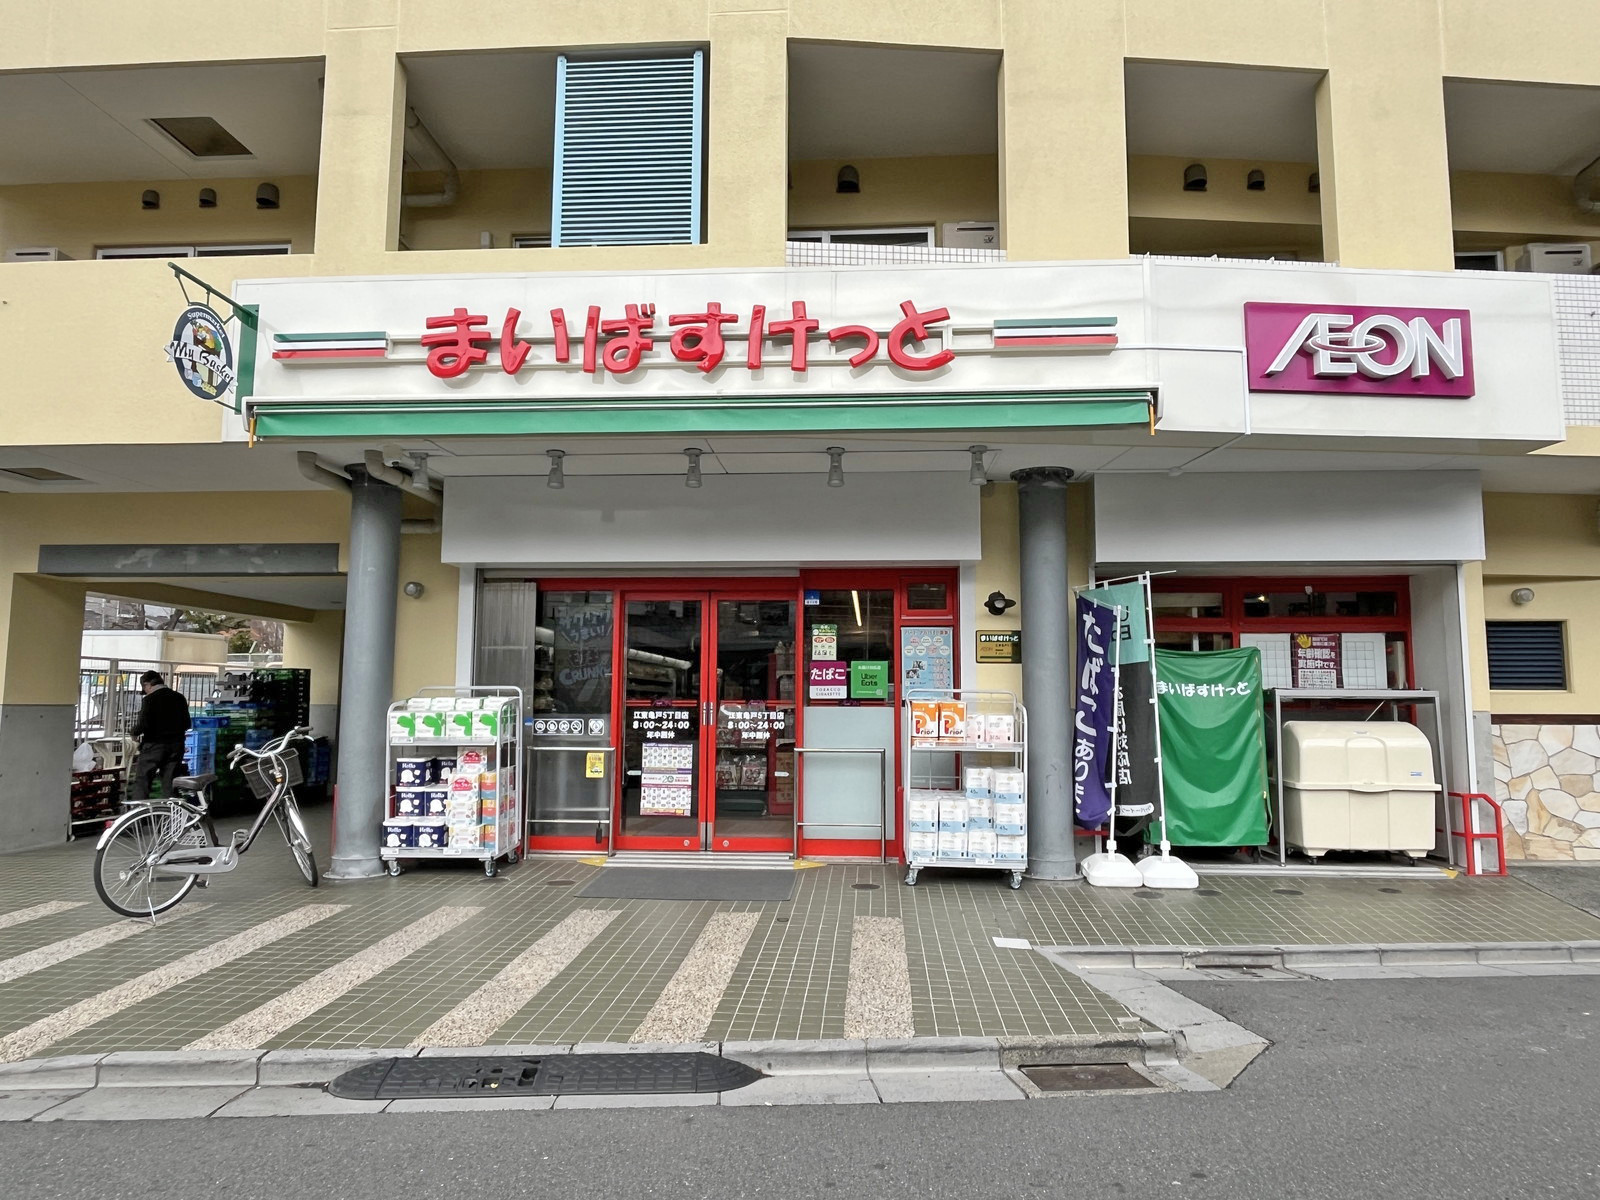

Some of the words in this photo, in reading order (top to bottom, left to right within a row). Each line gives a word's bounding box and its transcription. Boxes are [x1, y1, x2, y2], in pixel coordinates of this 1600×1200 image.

[187, 311, 226, 338] Supermarket
[421, 300, 956, 378] まいばすけっと
[1265, 313, 1464, 379] AEON
[170, 341, 195, 361] My
[199, 351, 235, 385] Basket
[810, 667, 846, 680] たばこ
[1156, 680, 1251, 698] まいばすけっと
[633, 711, 689, 720] 江東亀戸5丁目店
[728, 711, 785, 720] 江東亀戸5丁目店
[646, 731, 676, 739] 年中無休
[741, 731, 771, 740] 年中無休
